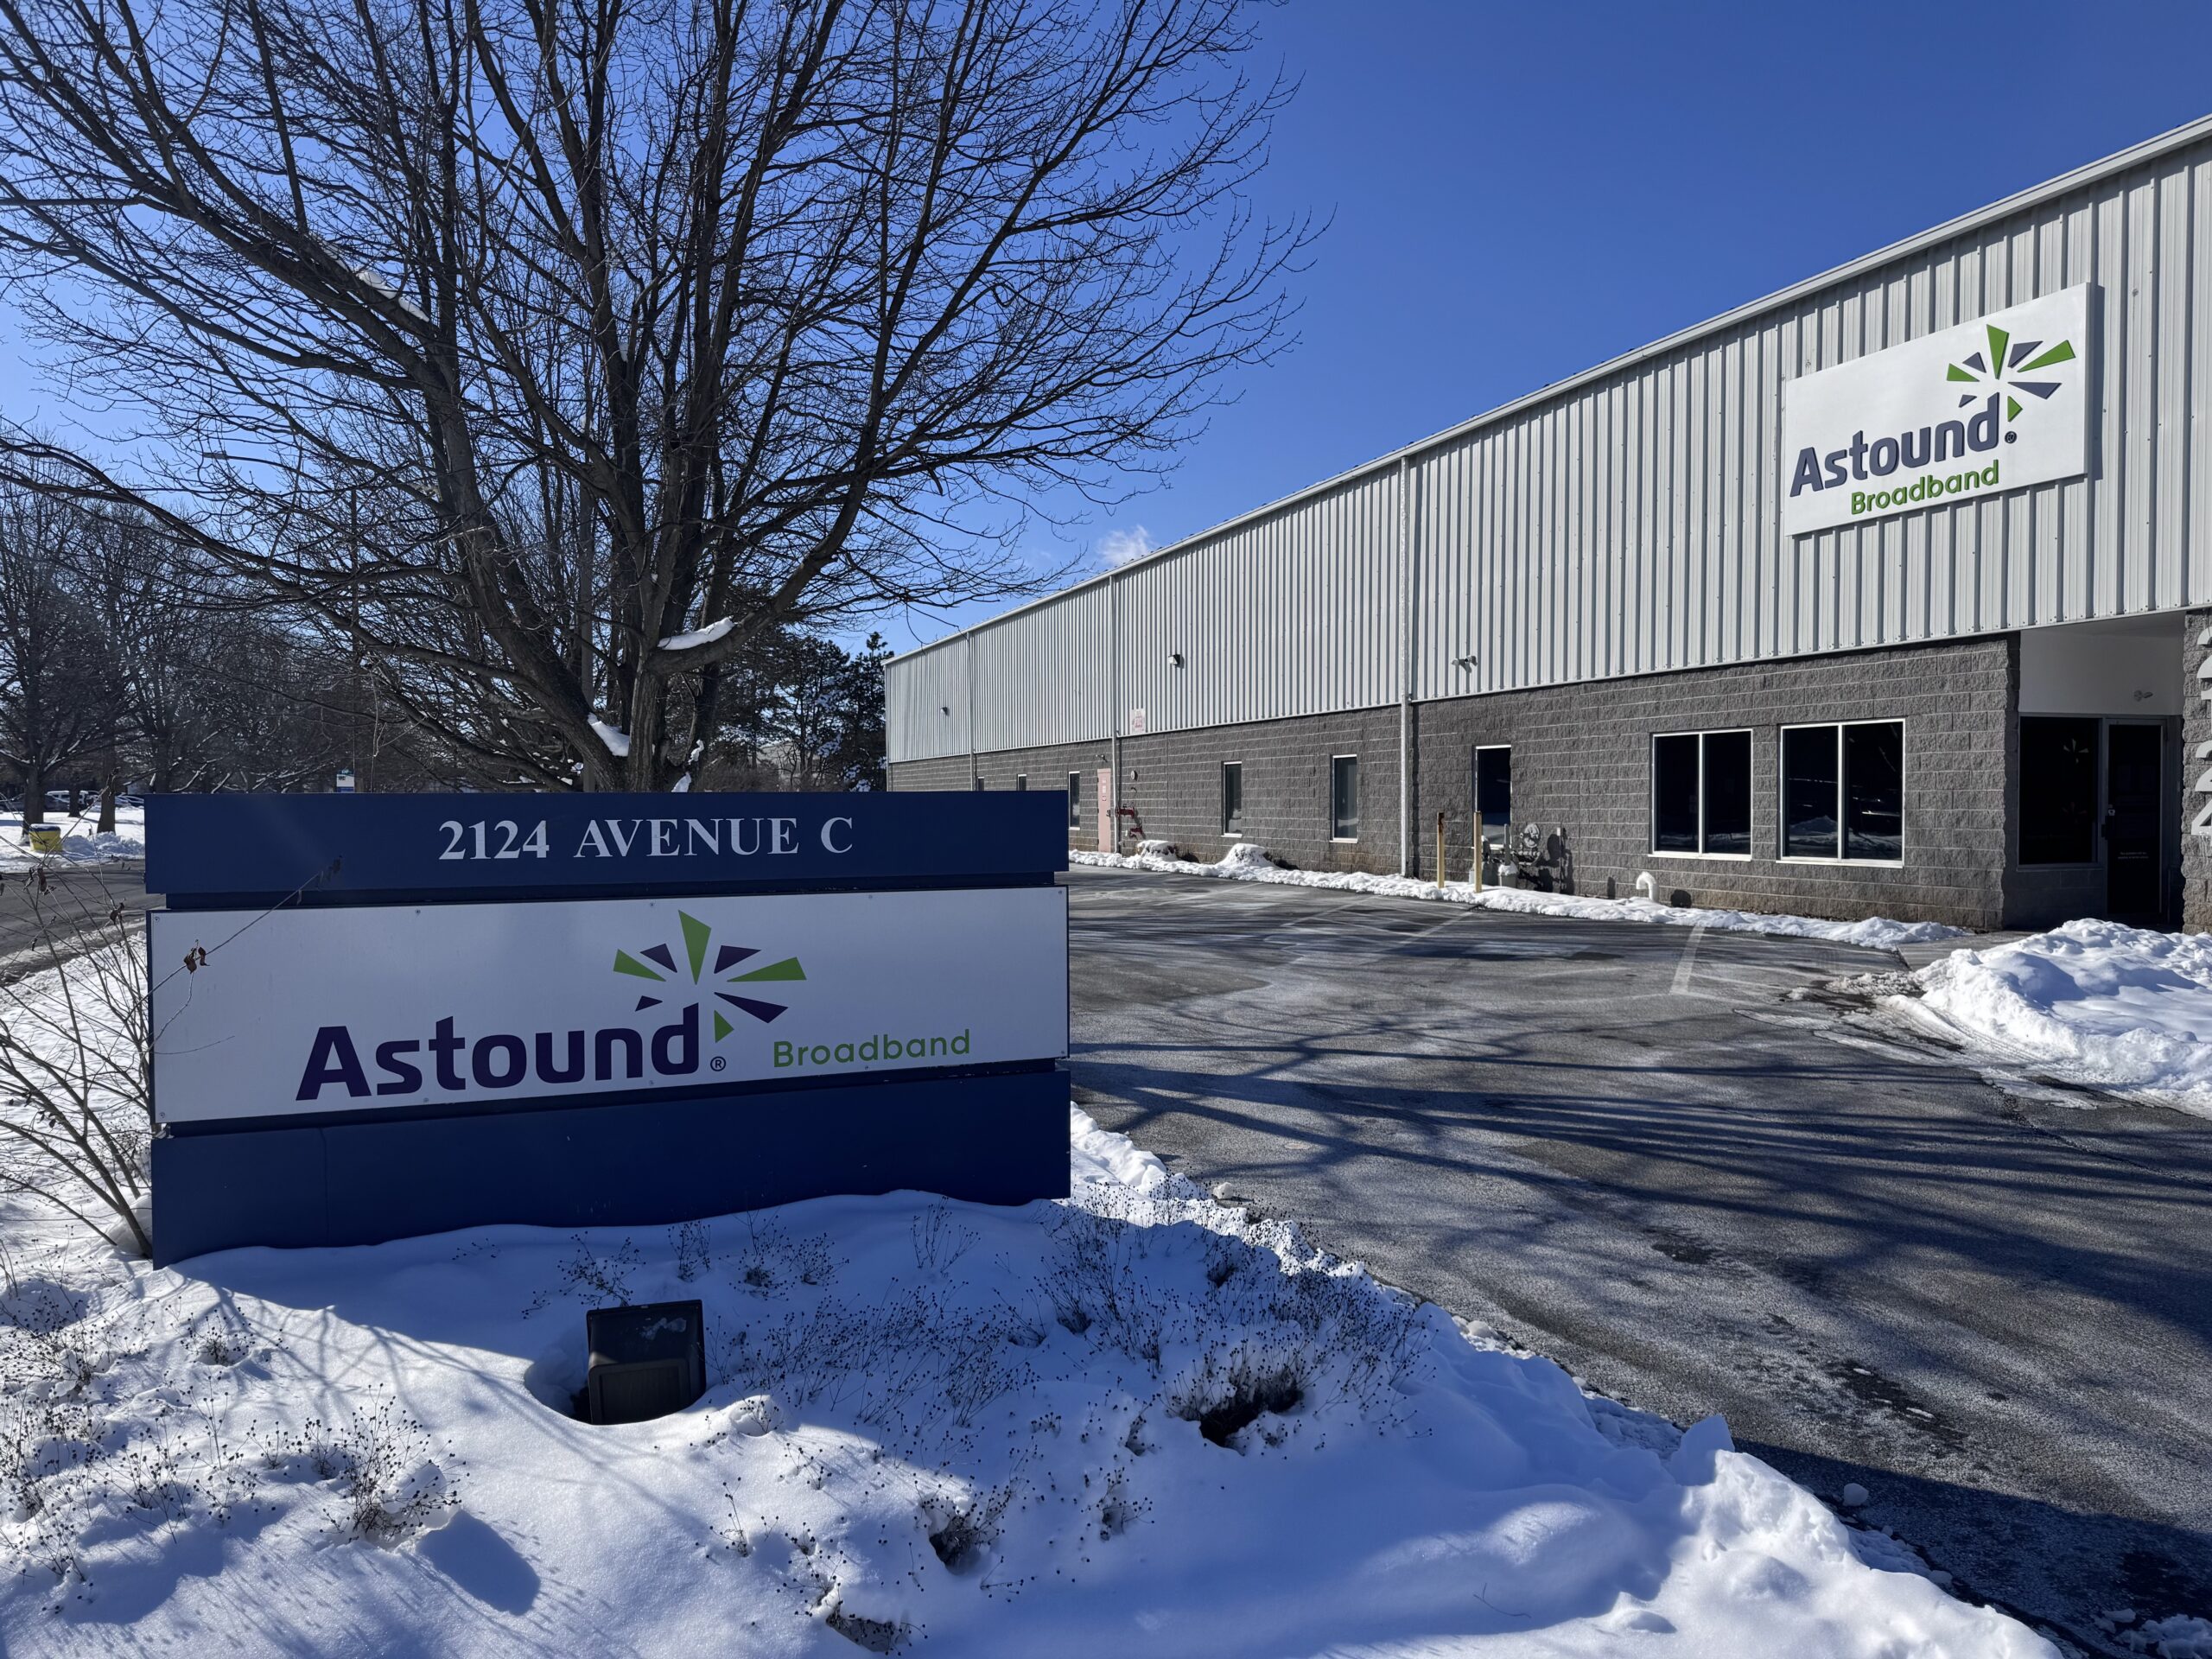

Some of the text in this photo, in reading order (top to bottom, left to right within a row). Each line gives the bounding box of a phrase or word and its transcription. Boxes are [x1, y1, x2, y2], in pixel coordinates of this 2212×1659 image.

[1851, 459, 1999, 514] Broadband
[438, 817, 853, 860] 2124 AVENUE C
[772, 1028, 972, 1069] Broadband
